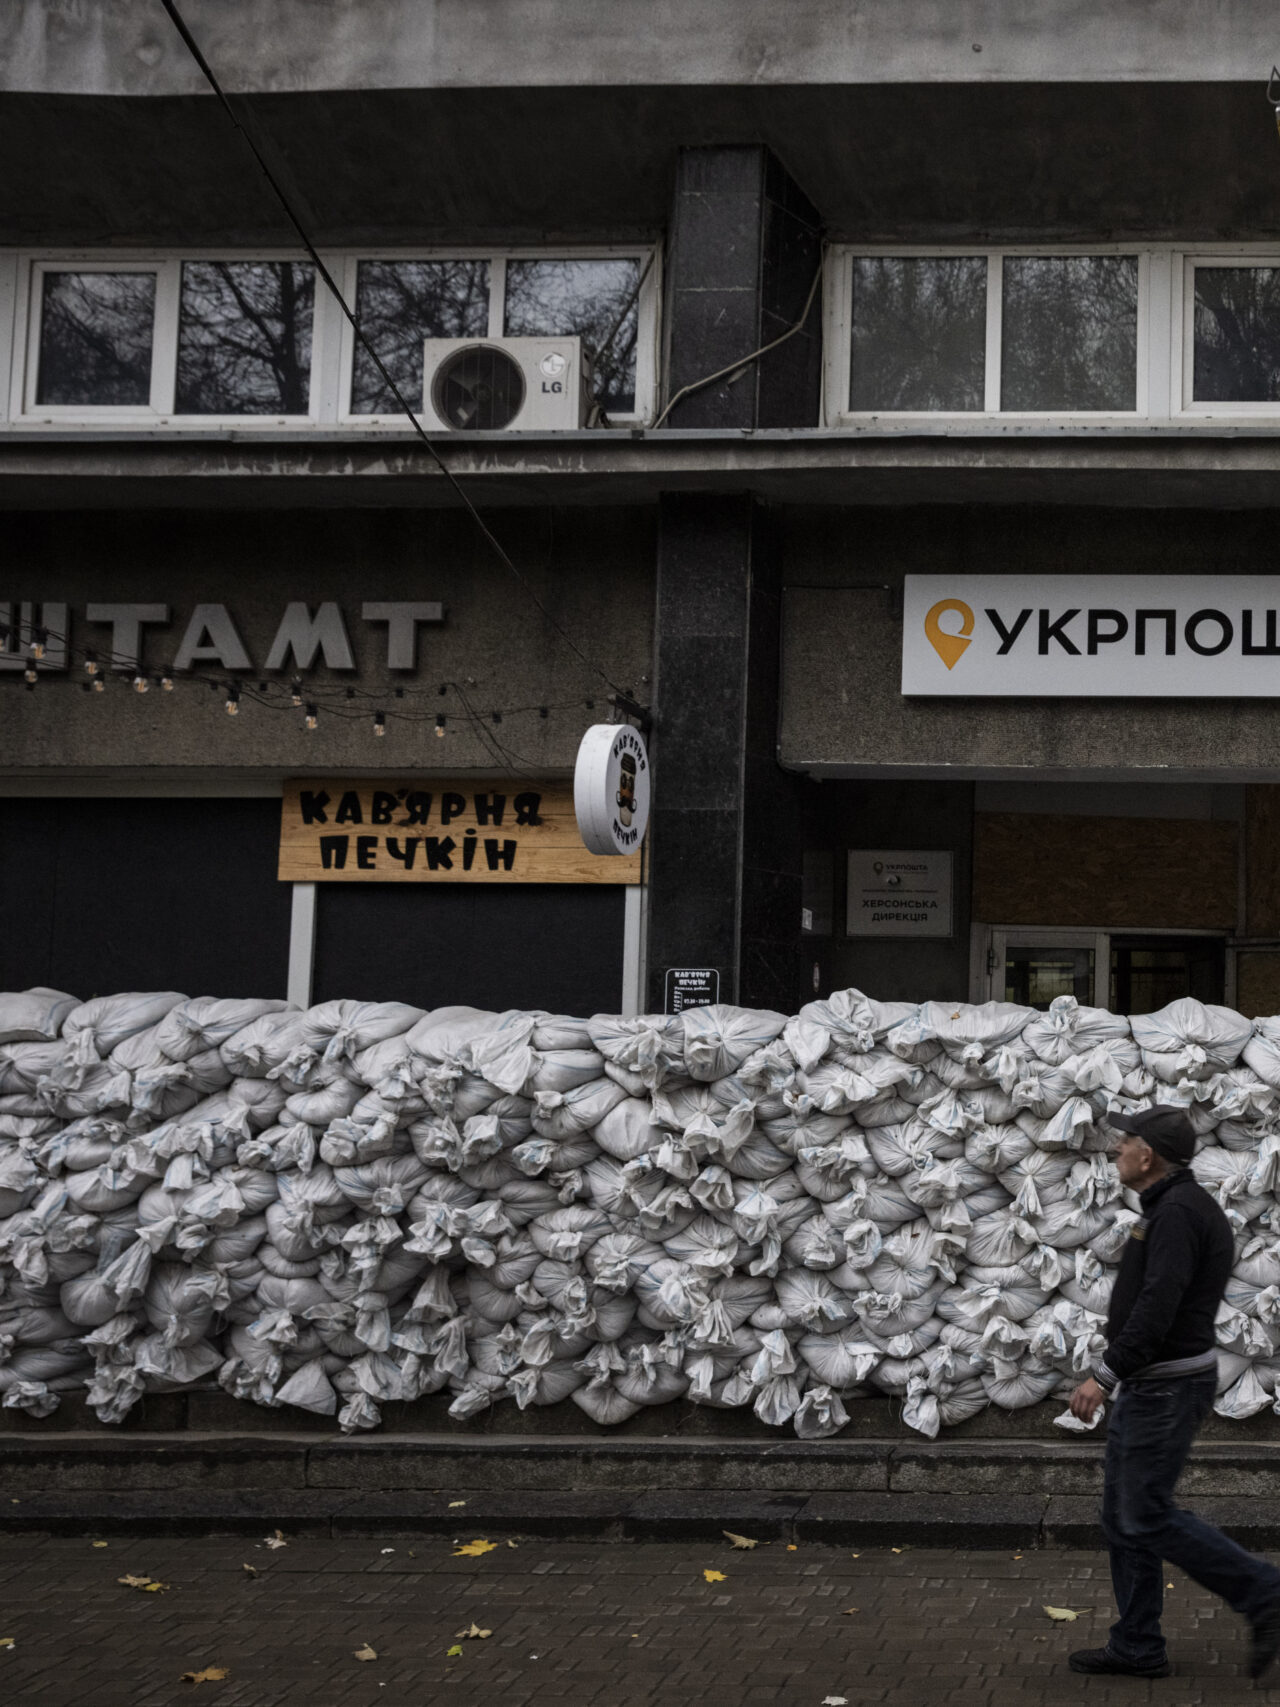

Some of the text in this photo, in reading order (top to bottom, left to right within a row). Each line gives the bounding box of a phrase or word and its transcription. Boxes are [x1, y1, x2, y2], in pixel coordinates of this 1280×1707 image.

[541, 381, 563, 394] LG
[862, 899, 938, 910] ХЕРСОНСЬКА
[872, 912, 928, 922] ДИРЕКЦІЯ
